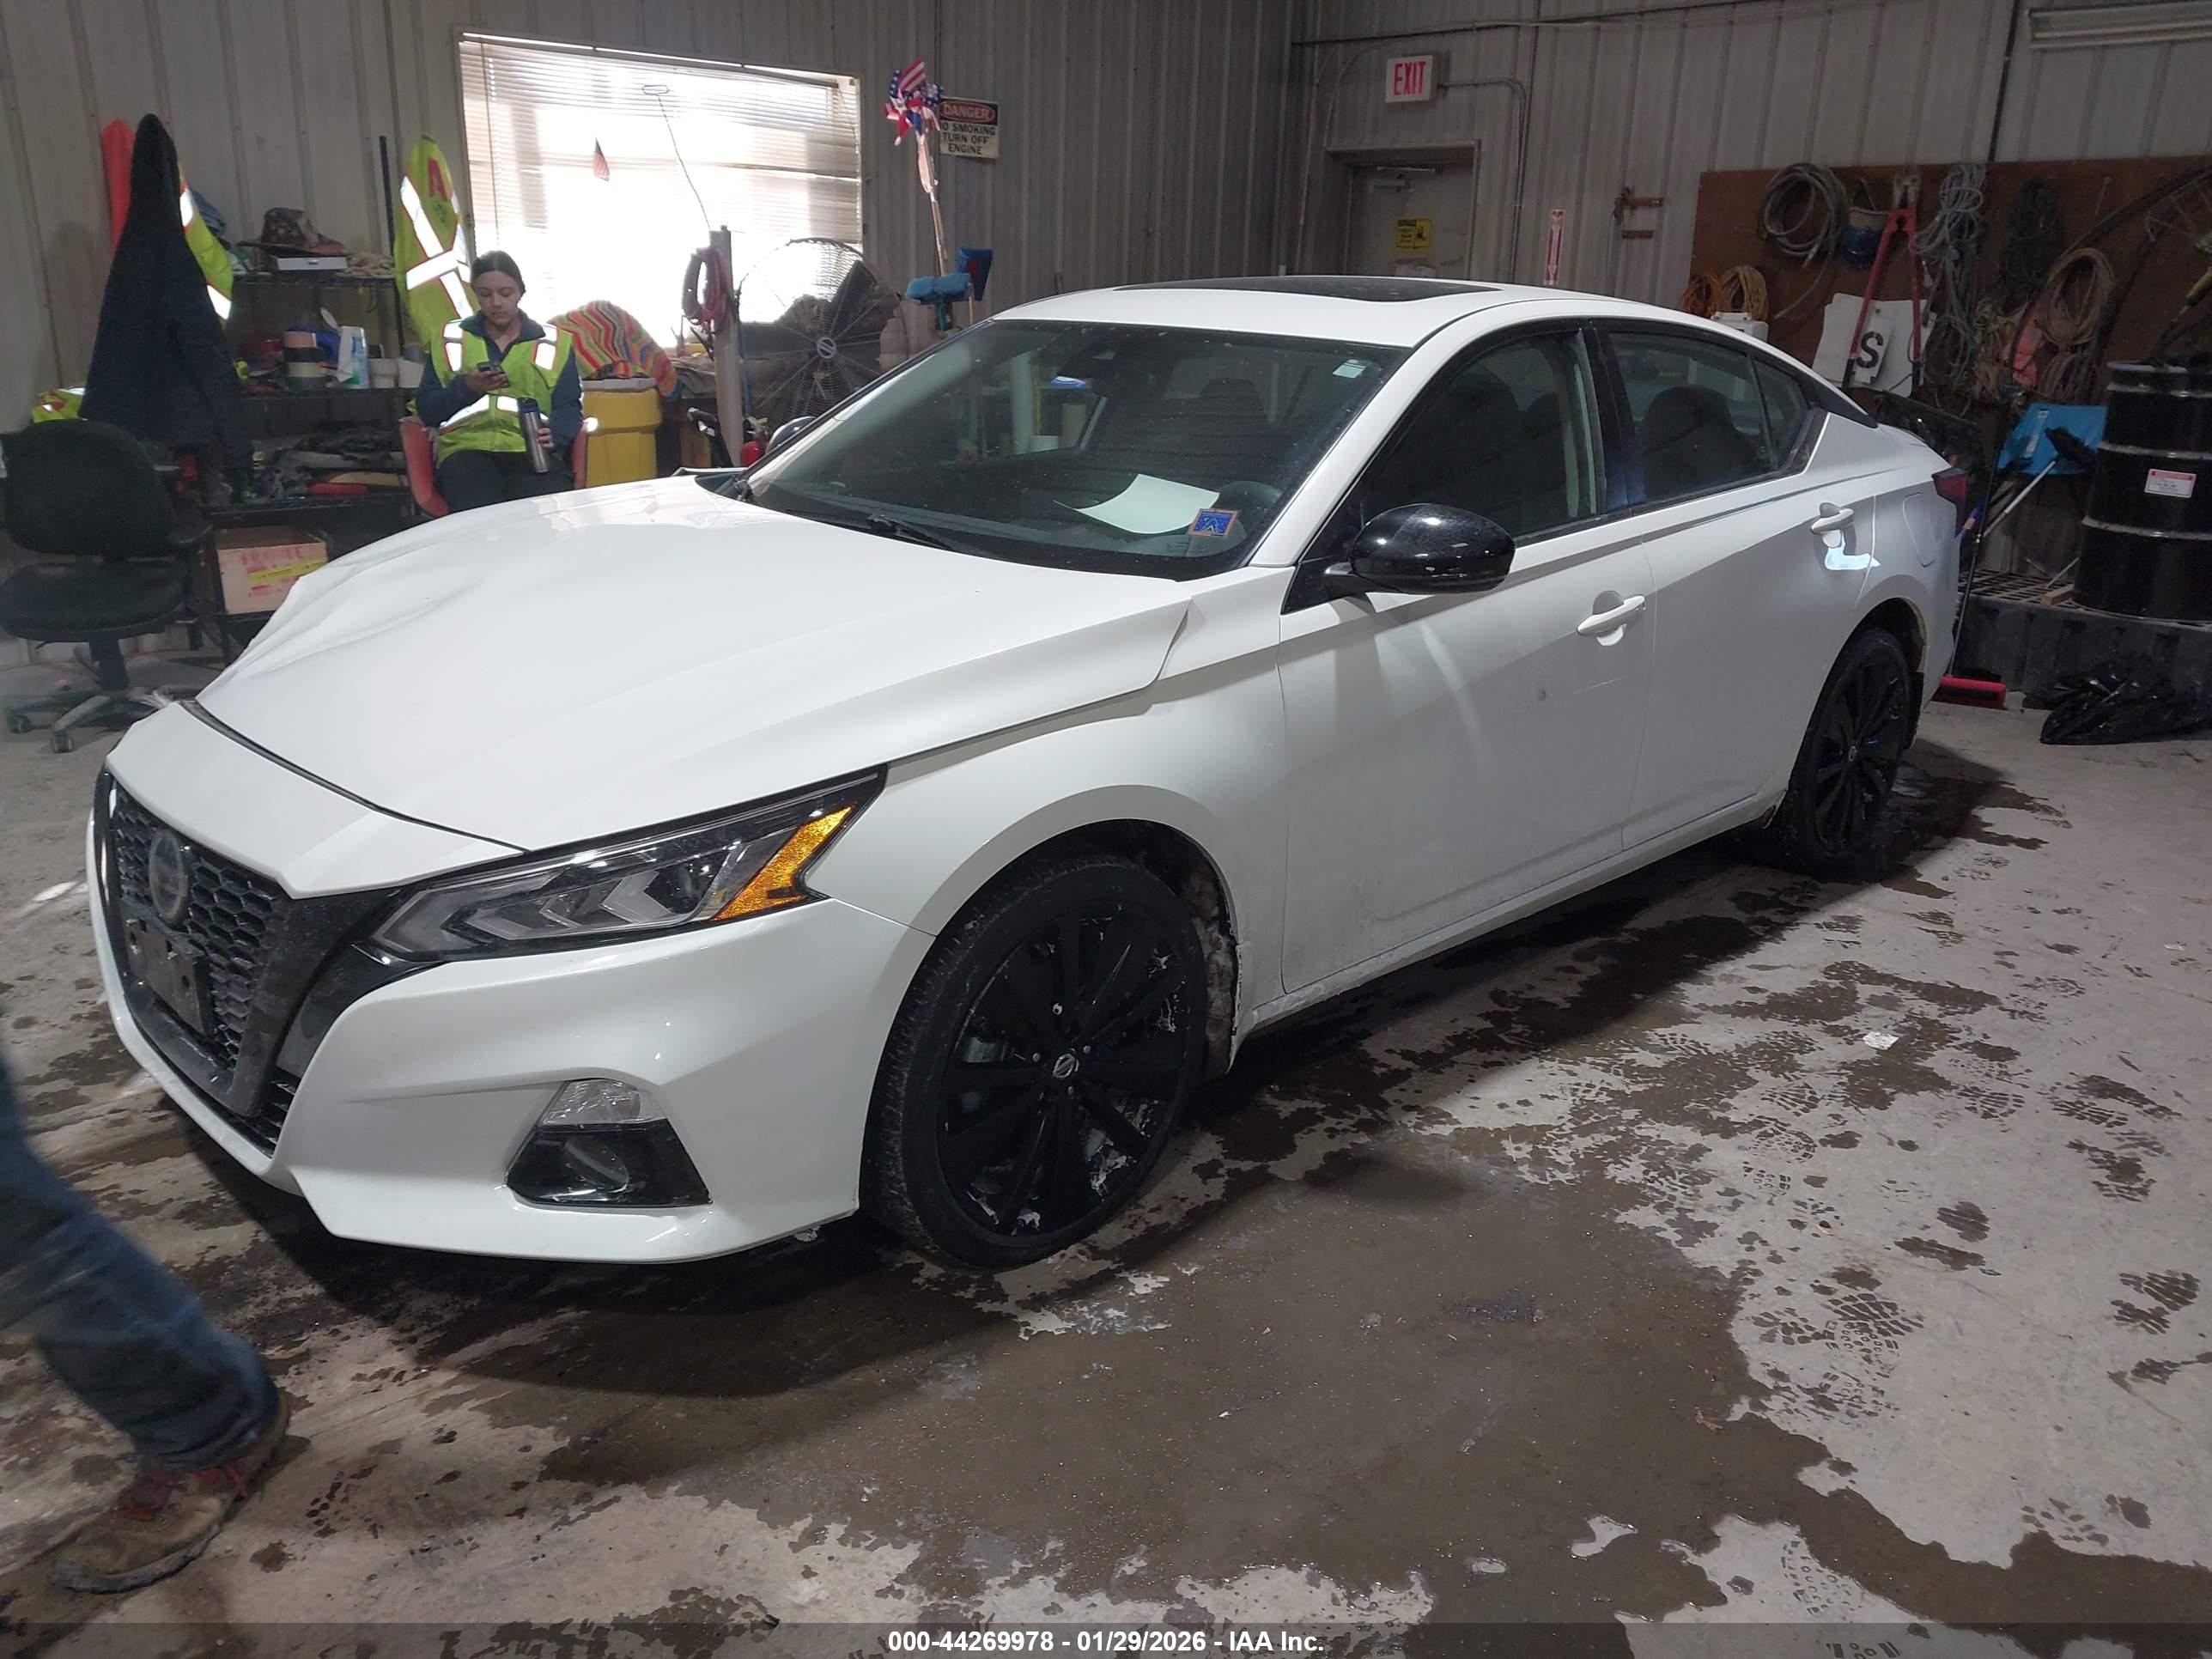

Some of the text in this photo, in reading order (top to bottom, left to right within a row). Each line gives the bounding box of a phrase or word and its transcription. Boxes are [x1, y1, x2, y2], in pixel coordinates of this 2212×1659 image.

[1394, 61, 1427, 96] EXIT
[944, 103, 989, 120] DANGER
[952, 122, 996, 136] SMOKING
[943, 131, 990, 144] TURN OFF
[948, 143, 983, 155] ENGINE
[1856, 331, 1884, 369] S
